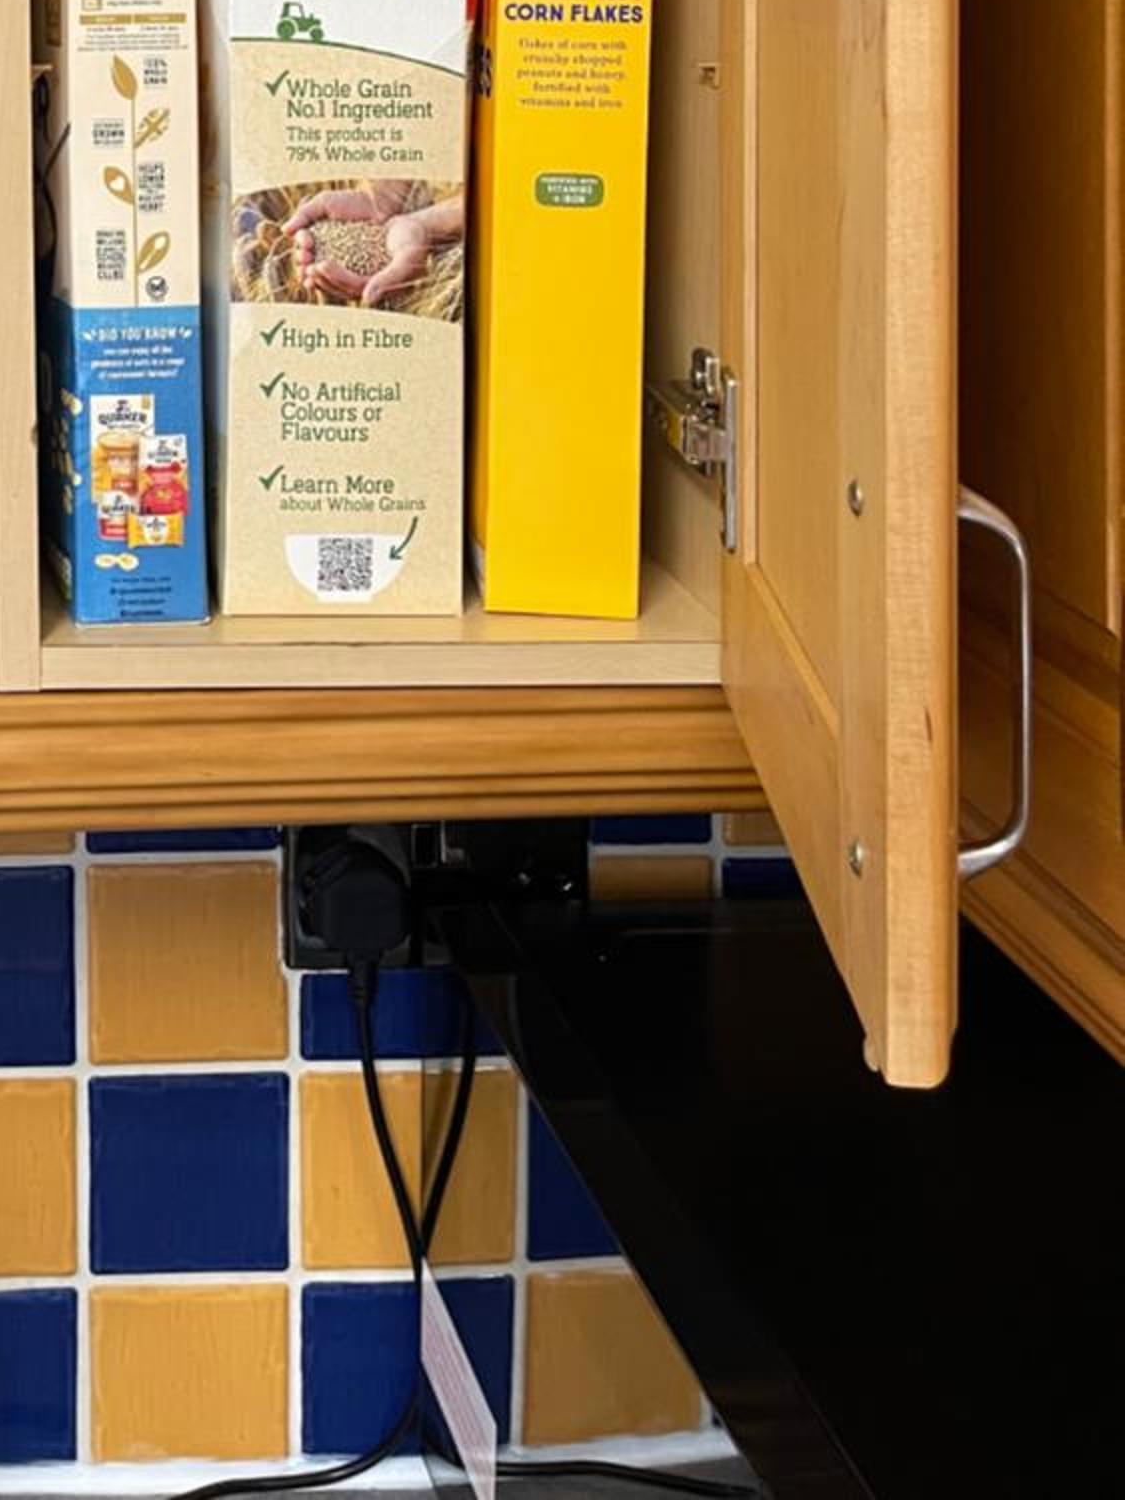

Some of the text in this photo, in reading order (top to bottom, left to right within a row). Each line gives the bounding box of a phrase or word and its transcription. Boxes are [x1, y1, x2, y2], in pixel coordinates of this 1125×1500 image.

[504, 3, 644, 23] CORN FLAKES
[286, 79, 413, 98] Whole Grain
[286, 100, 434, 124] No.1 Ingredient
[285, 126, 404, 145] This product is
[285, 146, 424, 162] 79% Whole Grain
[98, 327, 117, 342] DID
[122, 326, 143, 341] YOU
[282, 328, 413, 353] High in Fibre
[282, 381, 401, 401] No Artificial
[281, 402, 383, 422] Colours or
[281, 421, 370, 442] Flavours
[280, 474, 395, 494] Learn More
[280, 496, 427, 512] about Whole Grains
